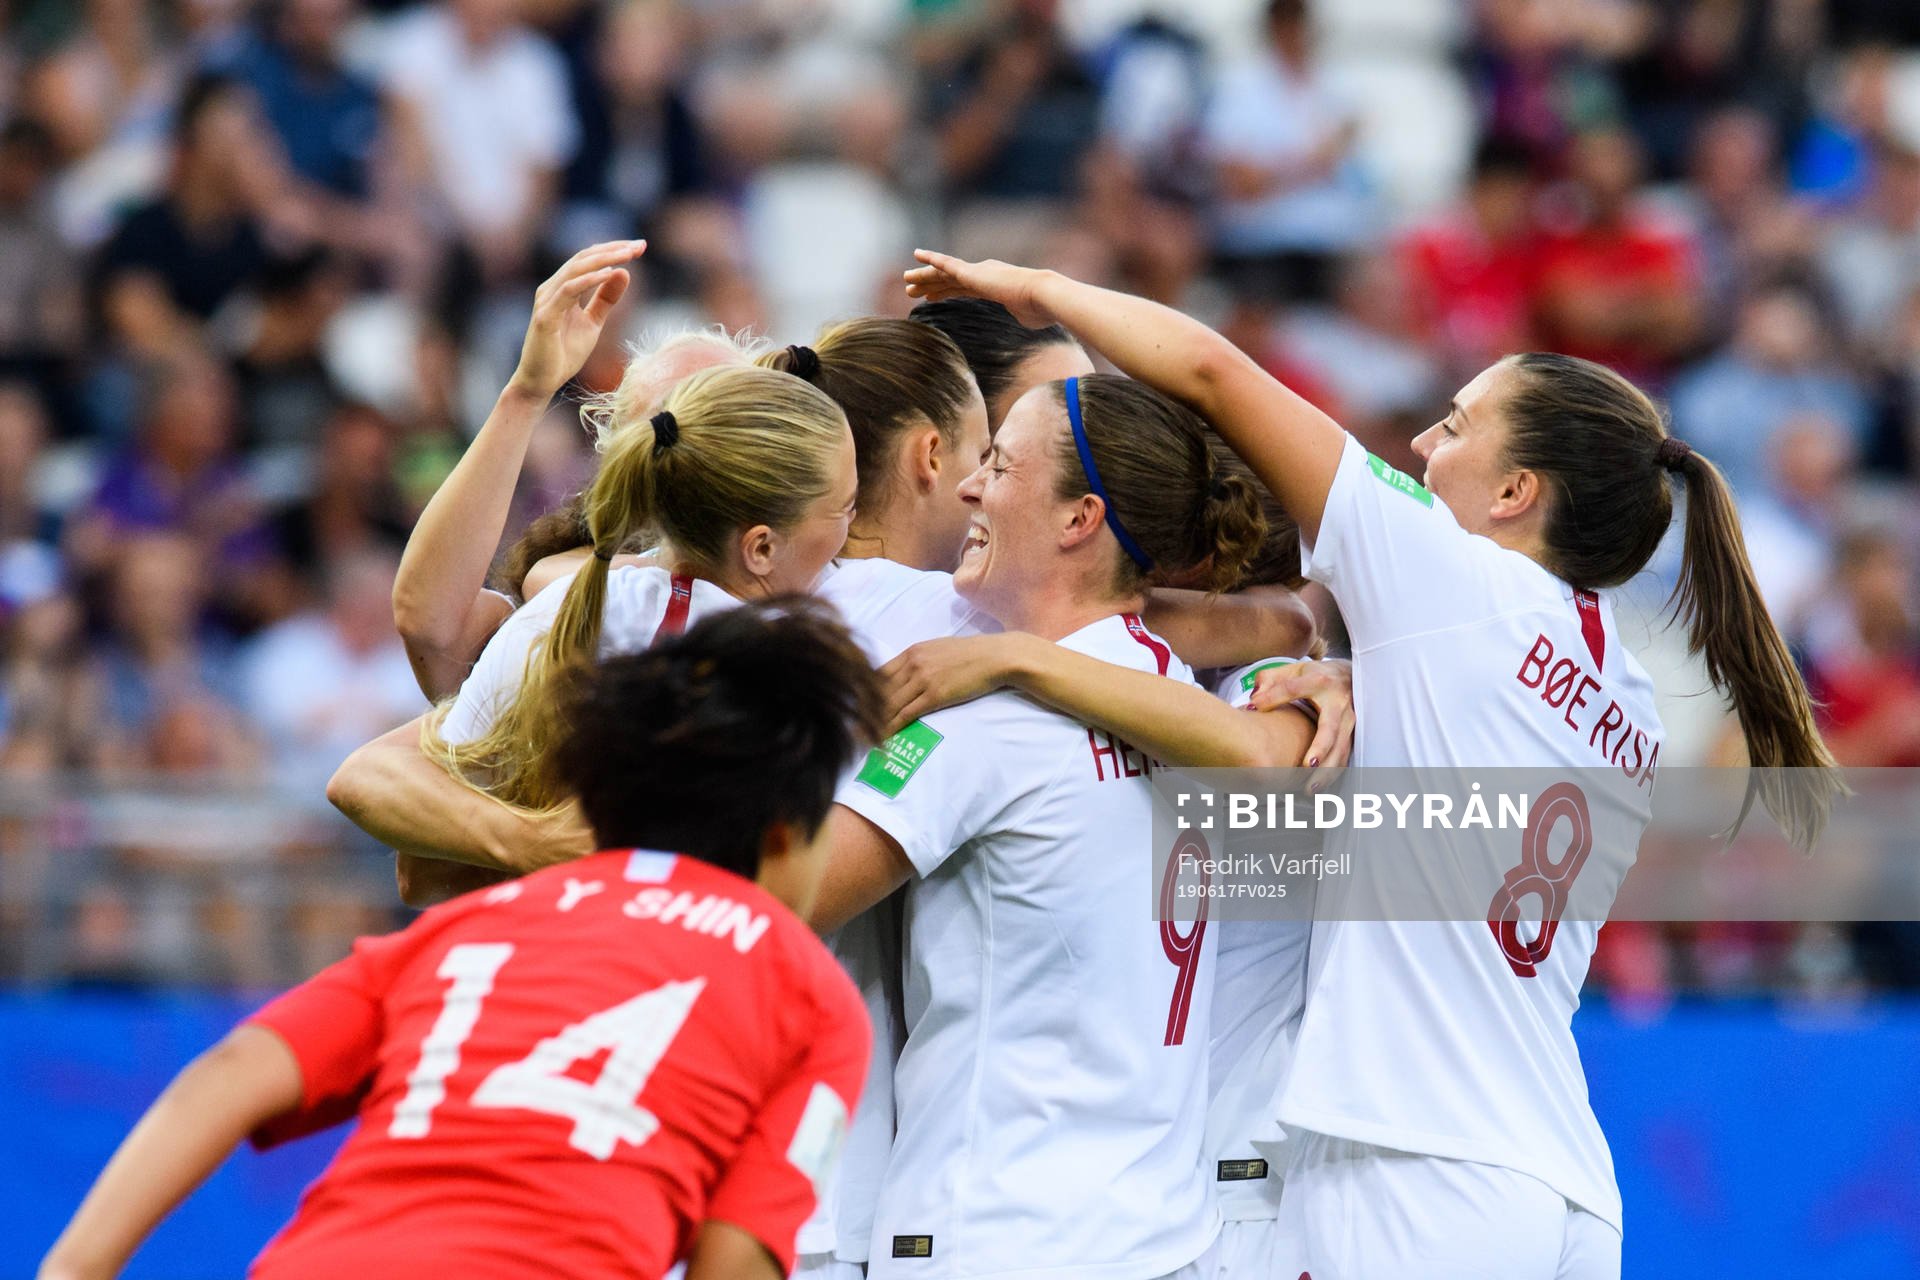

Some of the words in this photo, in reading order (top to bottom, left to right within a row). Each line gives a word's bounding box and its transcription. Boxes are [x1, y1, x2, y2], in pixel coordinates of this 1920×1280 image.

[884, 761, 909, 780] FIFA
[1516, 633, 1602, 732] BØE
[1589, 700, 1660, 797] RISA
[622, 888, 770, 954] SHIN
[1159, 827, 1212, 1046] 9
[1486, 781, 1592, 978] 8
[387, 942, 708, 1161] 14
